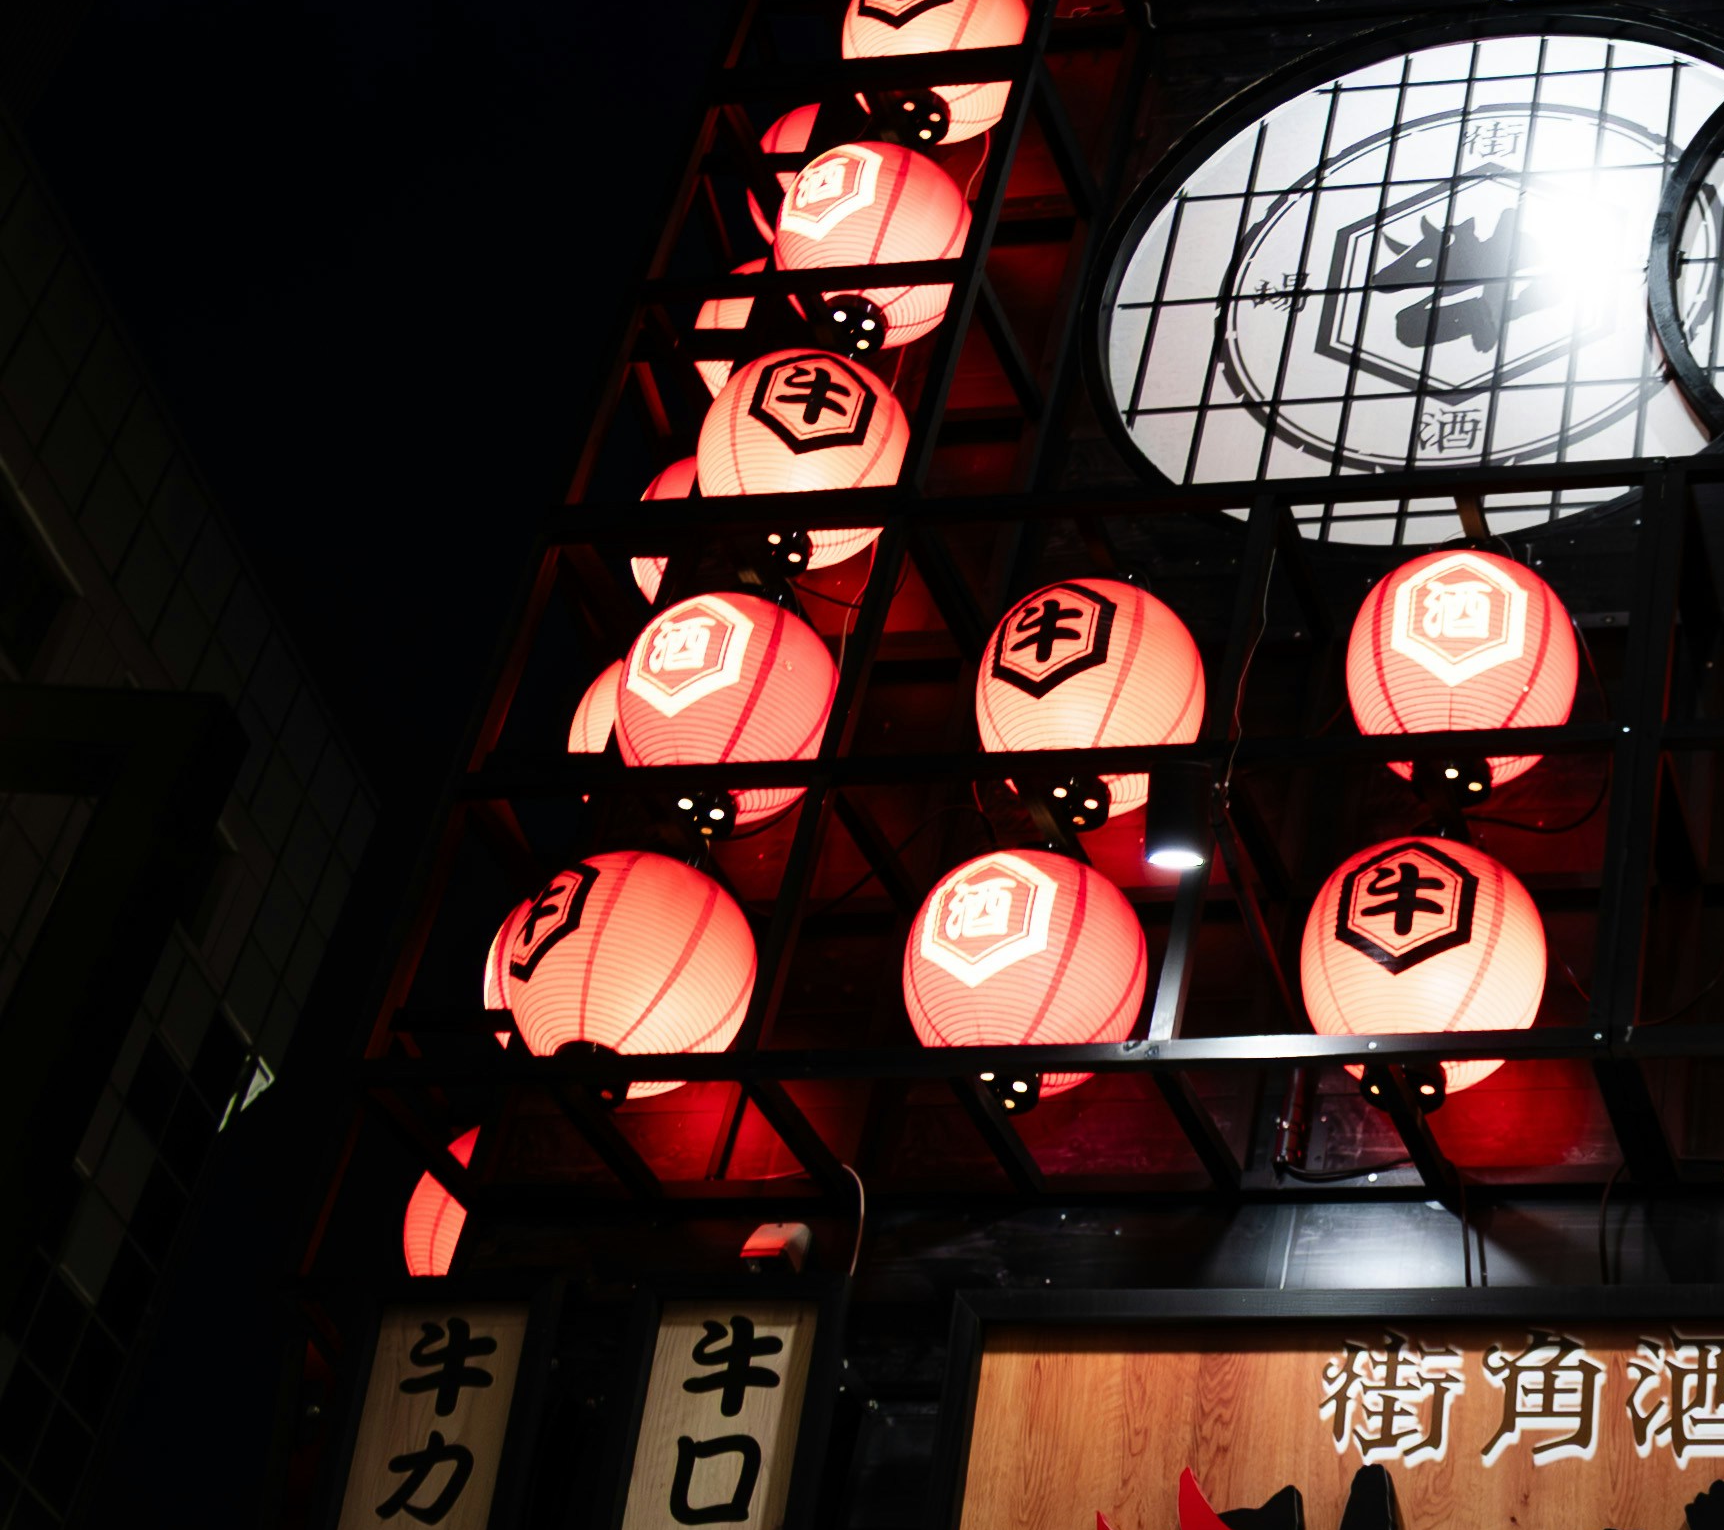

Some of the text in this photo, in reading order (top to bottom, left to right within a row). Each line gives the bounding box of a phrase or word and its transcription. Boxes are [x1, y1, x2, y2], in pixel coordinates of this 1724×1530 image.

[1463, 121, 1524, 158] 街
[795, 157, 847, 208] 酒
[776, 365, 853, 425] 牛
[1416, 408, 1484, 455] 酒
[1010, 598, 1084, 664] 牛
[1422, 580, 1491, 642] 酒
[651, 618, 715, 673] 酒
[946, 879, 1016, 940] 酒
[1361, 862, 1446, 937] 牛
